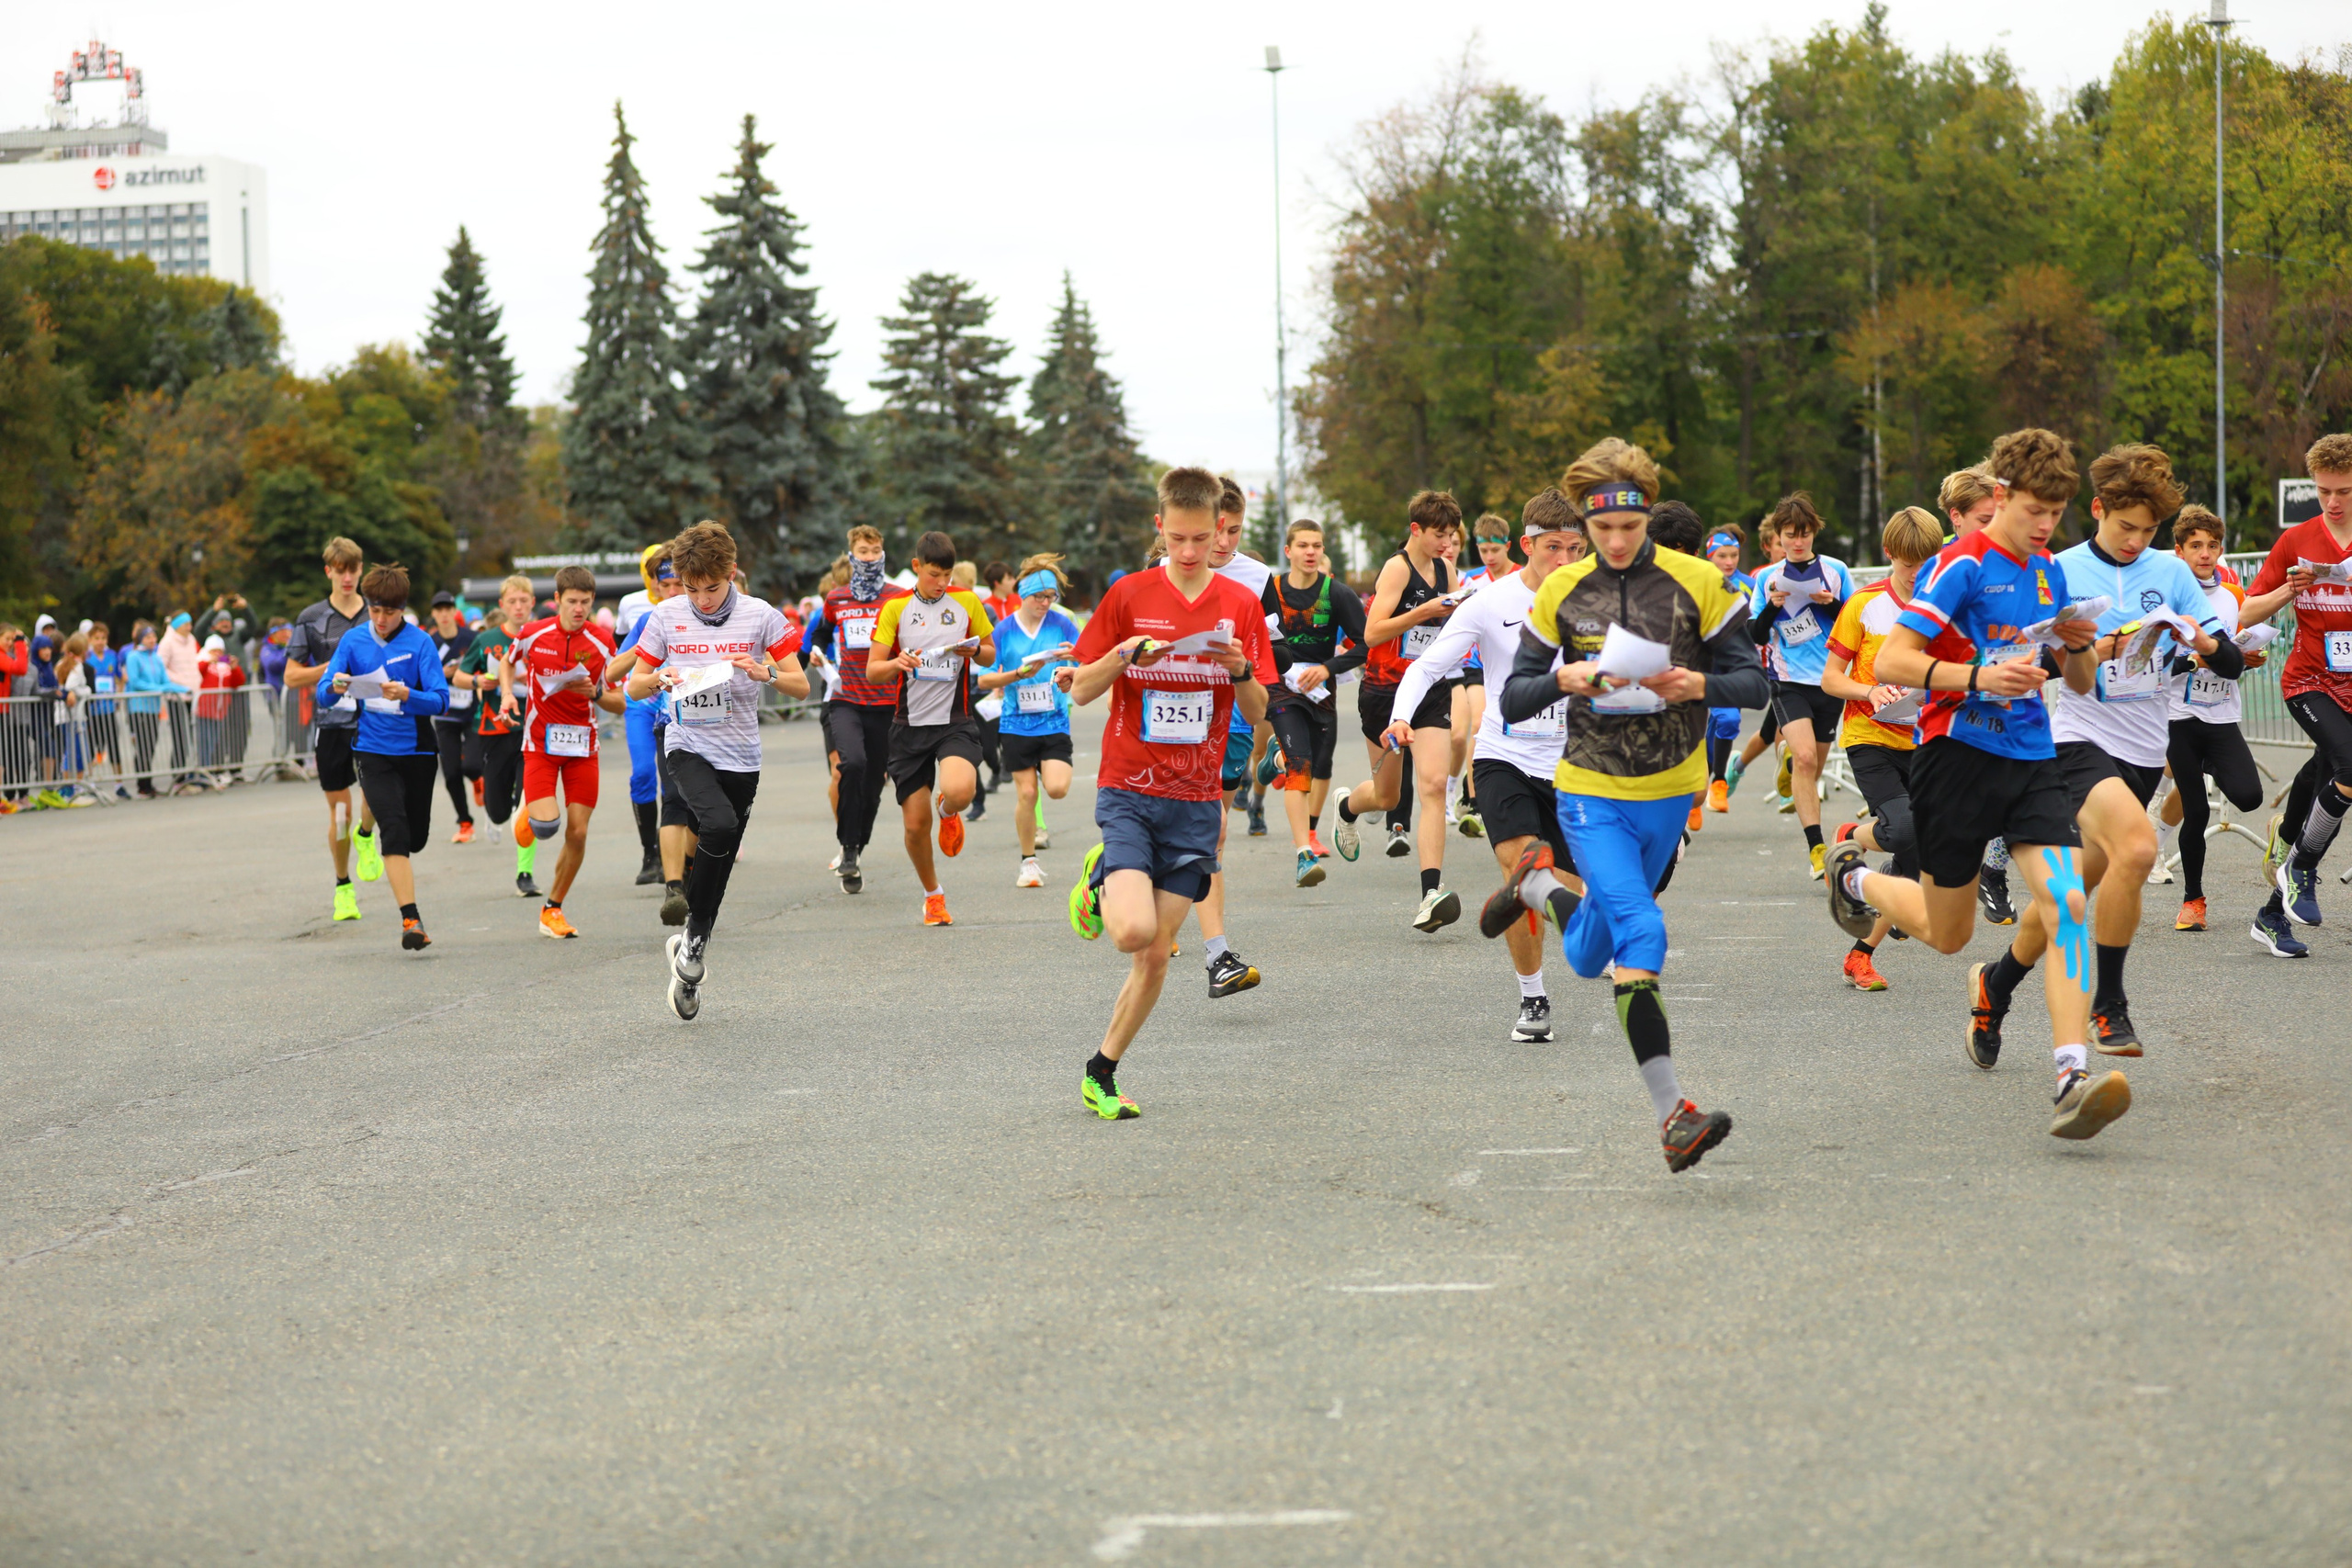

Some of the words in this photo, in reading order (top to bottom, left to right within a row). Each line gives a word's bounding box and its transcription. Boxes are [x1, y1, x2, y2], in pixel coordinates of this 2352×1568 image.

[125, 164, 205, 186] azimut
[835, 609, 864, 620] NORD
[848, 626, 871, 637] 345.
[1784, 617, 1812, 637] 338.1
[1409, 630, 1437, 646] 347.
[535, 647, 558, 656] RUSSIA
[668, 644, 709, 654] NORD
[714, 642, 756, 653] WEST
[921, 658, 951, 669] 30.1
[2108, 658, 2154, 682] 3.1
[543, 668, 566, 677] SUU
[2192, 680, 2225, 694] 317.1
[682, 693, 722, 708] 342.1
[1020, 691, 1046, 702] 331.1
[1153, 705, 1204, 724] 325.1
[1987, 716, 2004, 734] 18
[551, 731, 582, 744] 322.1
